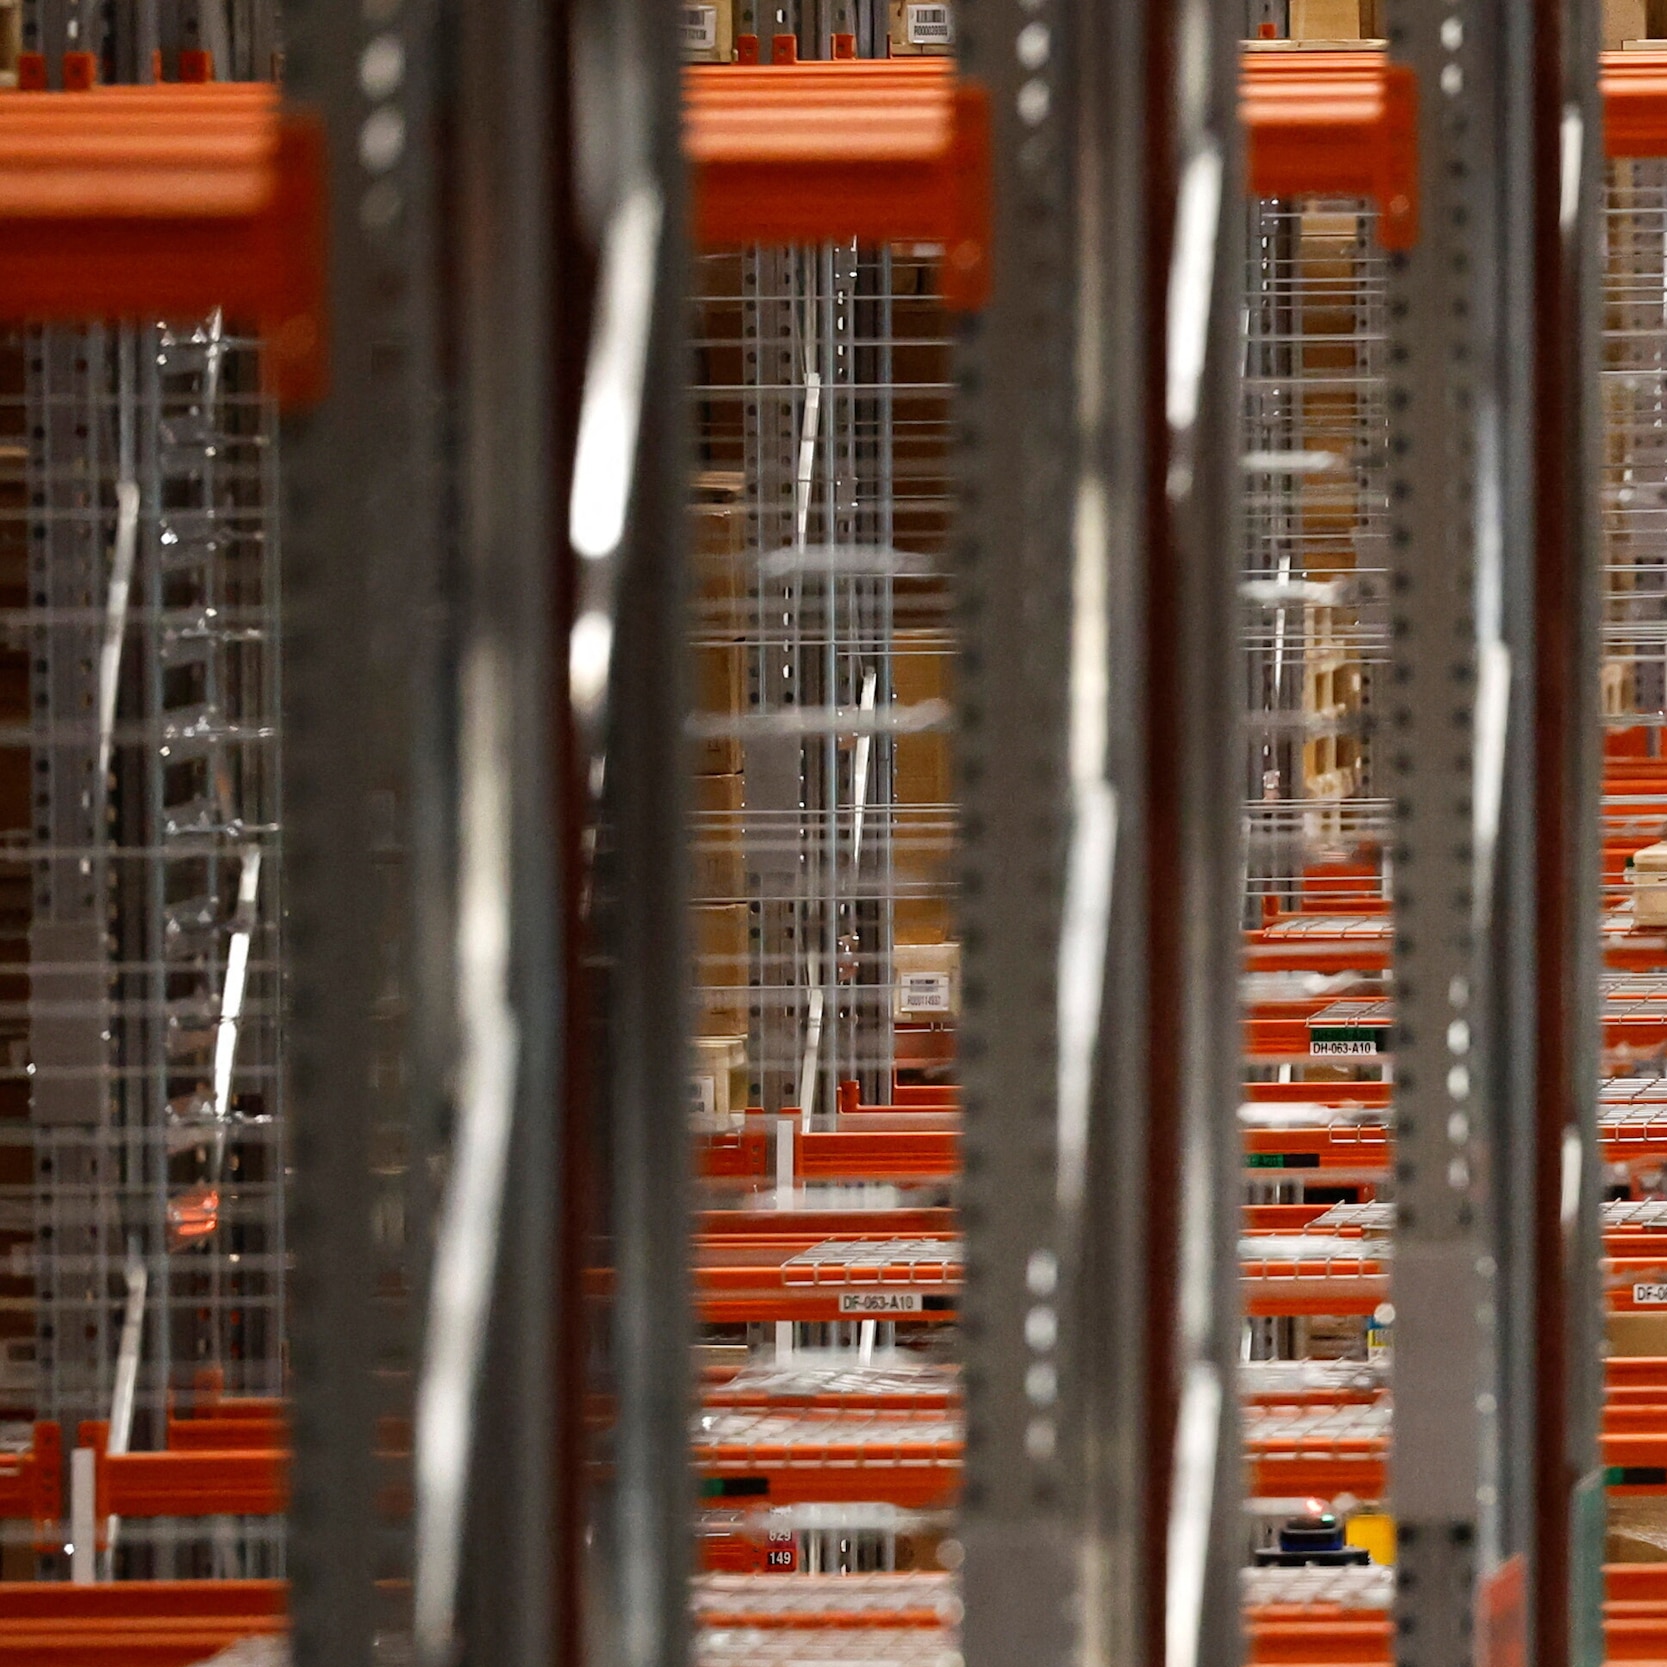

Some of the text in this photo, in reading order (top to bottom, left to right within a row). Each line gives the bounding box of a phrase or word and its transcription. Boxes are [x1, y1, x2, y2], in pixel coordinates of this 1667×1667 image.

[1313, 1042, 1371, 1054] DH-063-A10
[843, 1295, 914, 1310] DF-063-A10
[769, 1551, 791, 1565] 149
